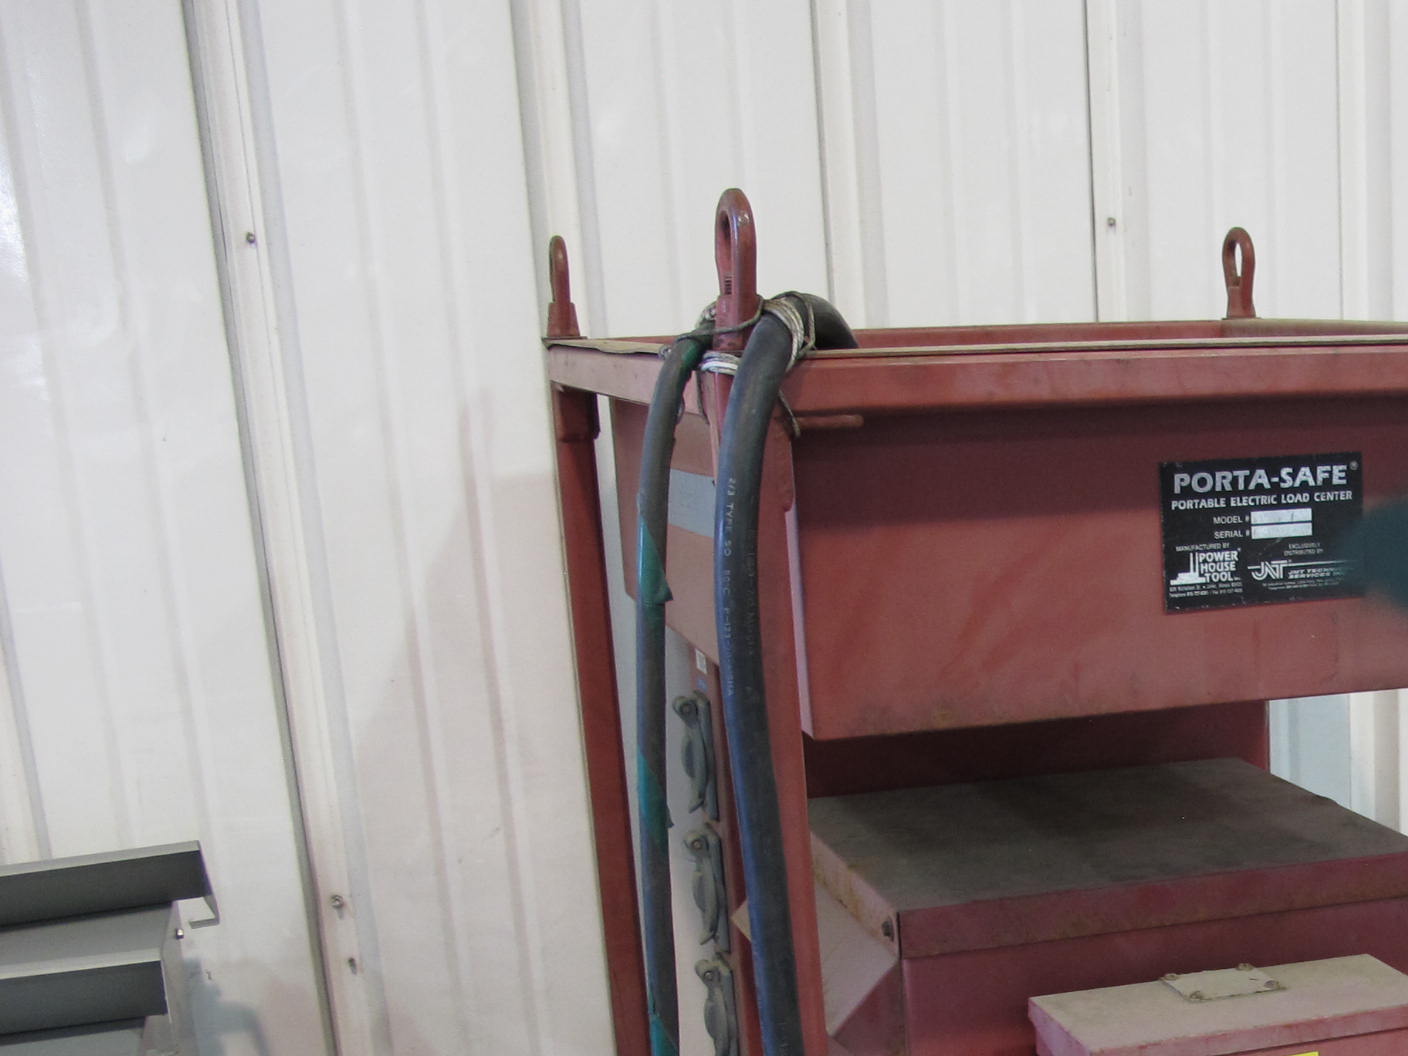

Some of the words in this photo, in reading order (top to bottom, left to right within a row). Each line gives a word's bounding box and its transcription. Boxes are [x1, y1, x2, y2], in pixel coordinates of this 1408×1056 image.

[1173, 465, 1347, 494] PORTA-SAFE
[1171, 498, 1226, 510] PORTABLE
[1230, 495, 1277, 507] ELECTRIC
[1281, 493, 1310, 504] LOAD
[1313, 490, 1352, 502] CENTER
[1213, 515, 1243, 525] MODEL
[1214, 529, 1243, 540] SERIAL
[1176, 543, 1222, 552] MANUFACTURED
[1199, 550, 1239, 562] POWER
[1200, 561, 1237, 574] HOUSE
[1204, 571, 1234, 583] TOOL
